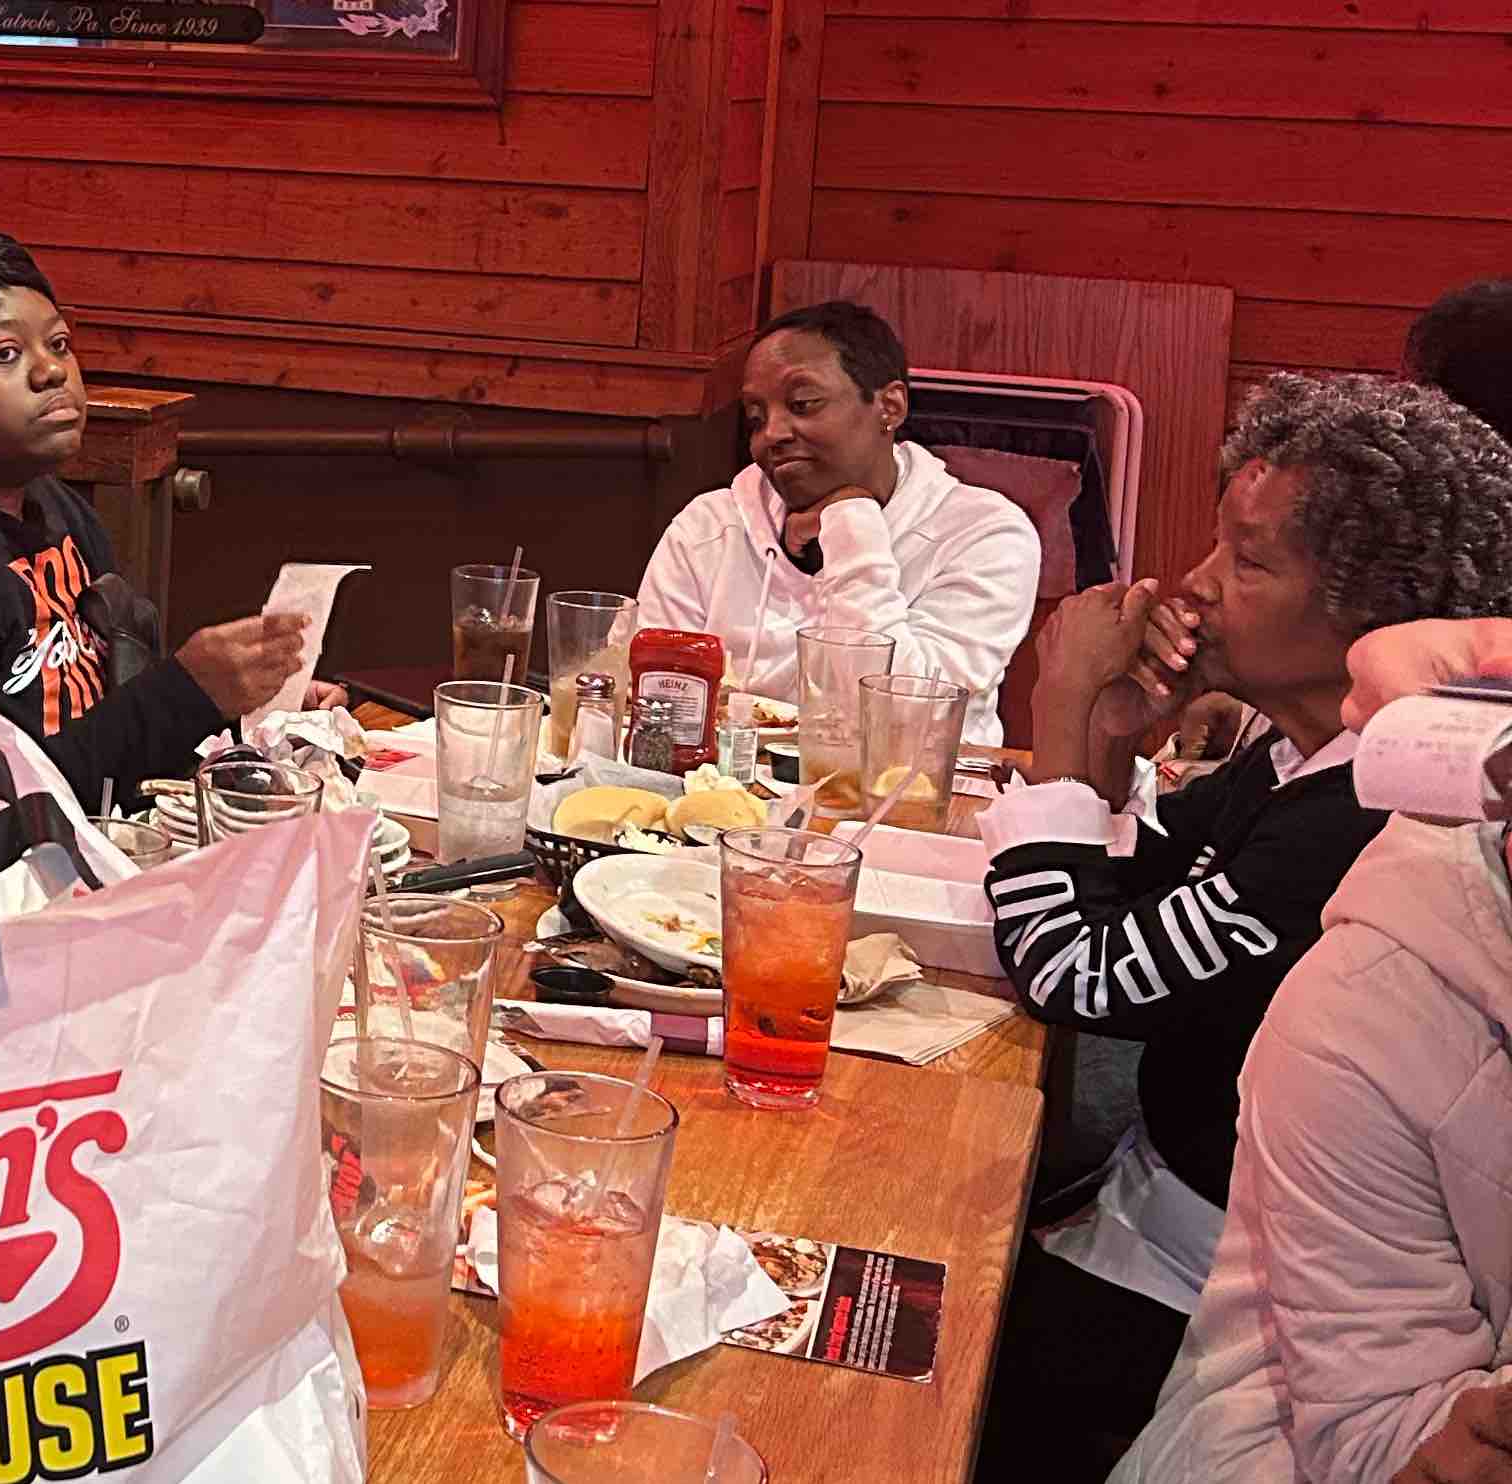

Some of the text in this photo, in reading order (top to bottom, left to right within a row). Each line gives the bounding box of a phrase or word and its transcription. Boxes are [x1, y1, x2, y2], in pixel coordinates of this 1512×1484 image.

[109, 8, 169, 35] Since
[172, 17, 220, 37] 1939
[657, 679, 689, 691] HEINZ
